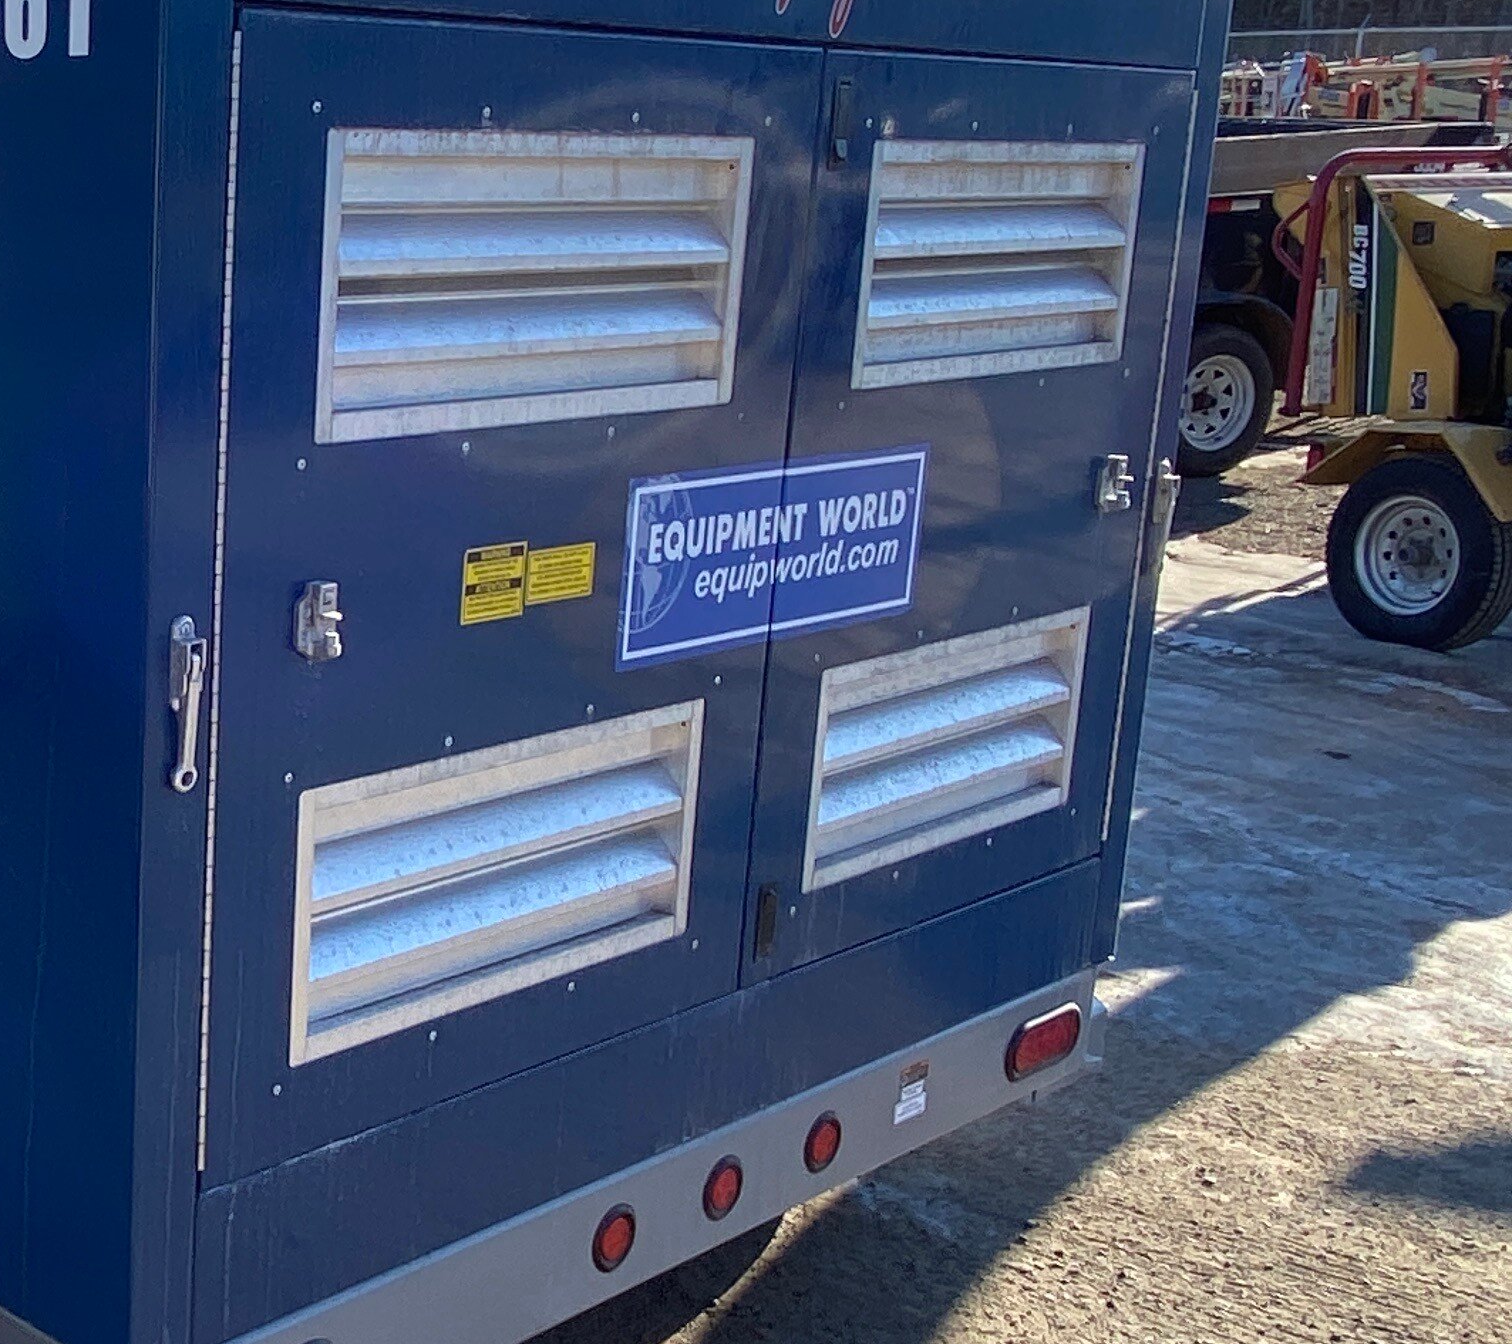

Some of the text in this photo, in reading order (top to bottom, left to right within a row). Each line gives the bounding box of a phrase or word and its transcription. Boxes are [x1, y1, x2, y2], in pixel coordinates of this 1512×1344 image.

[647, 488, 907, 564] EQUIPMENT WORLD
[693, 536, 900, 604] equipworld.com
